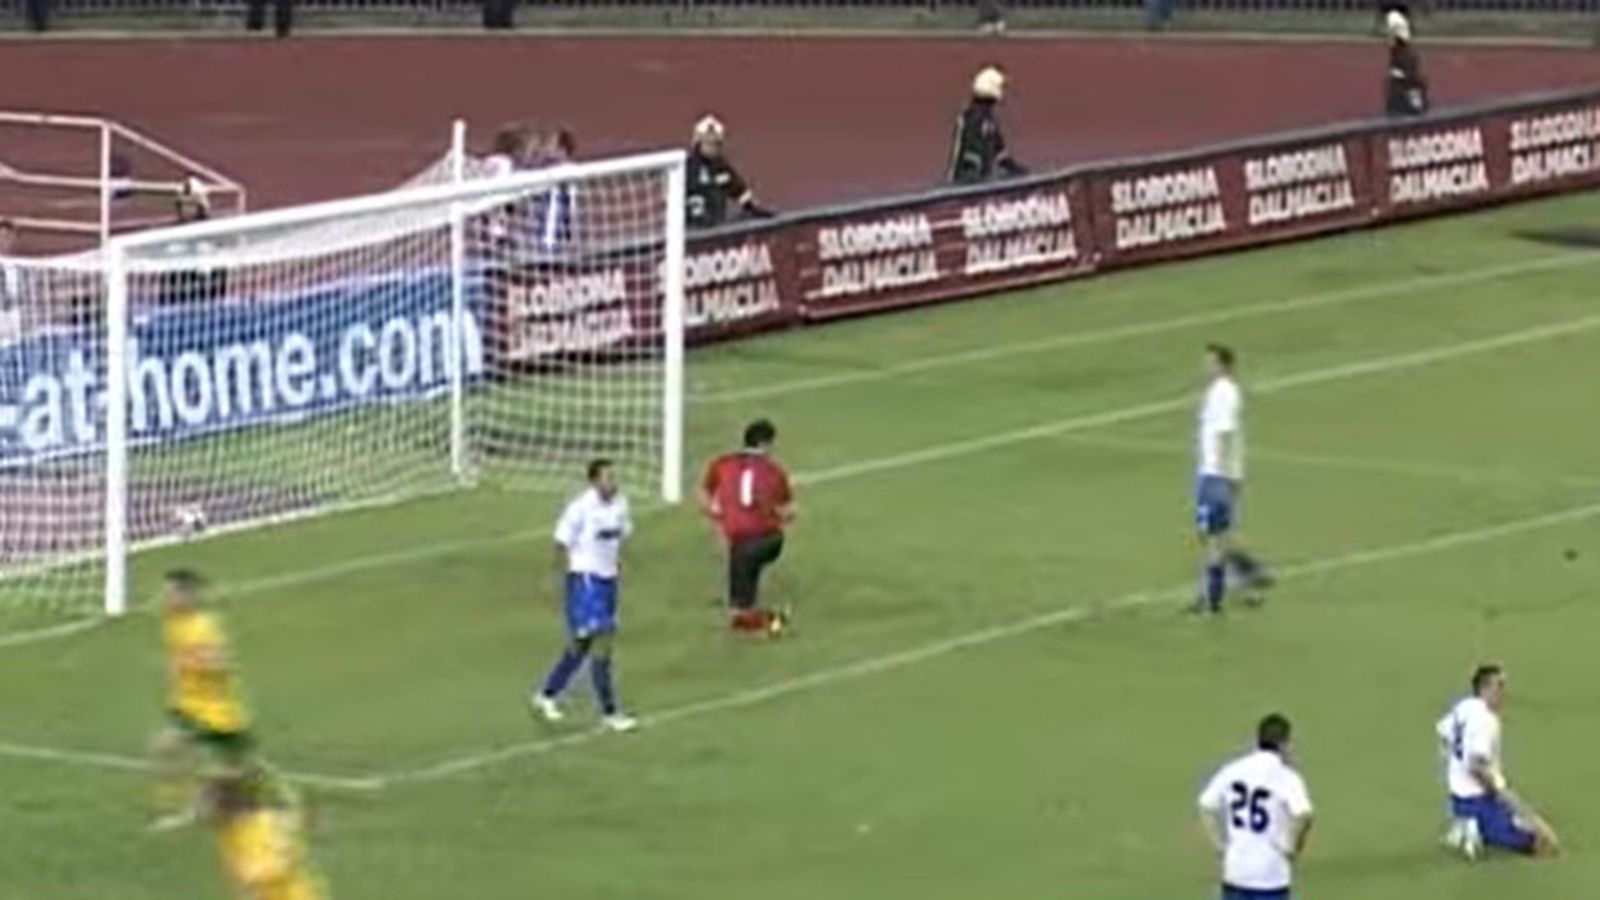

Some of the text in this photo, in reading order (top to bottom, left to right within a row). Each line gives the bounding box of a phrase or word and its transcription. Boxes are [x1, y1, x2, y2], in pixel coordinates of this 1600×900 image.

[1111, 166, 1219, 213] SLOBODNA
[1245, 144, 1347, 191] SLOBODNA
[961, 192, 1072, 238] SLOBODNA
[1116, 202, 1226, 248] DALMACIJA
[1249, 179, 1354, 225] DALMACIJA
[818, 213, 933, 260] SLOBODNA
[964, 228, 1078, 275] DALMACIJA
[658, 242, 773, 298] SOBODNA
[822, 249, 940, 296] DALMACIJA
[739, 469, 754, 507] 1
[1230, 780, 1271, 834] 26
